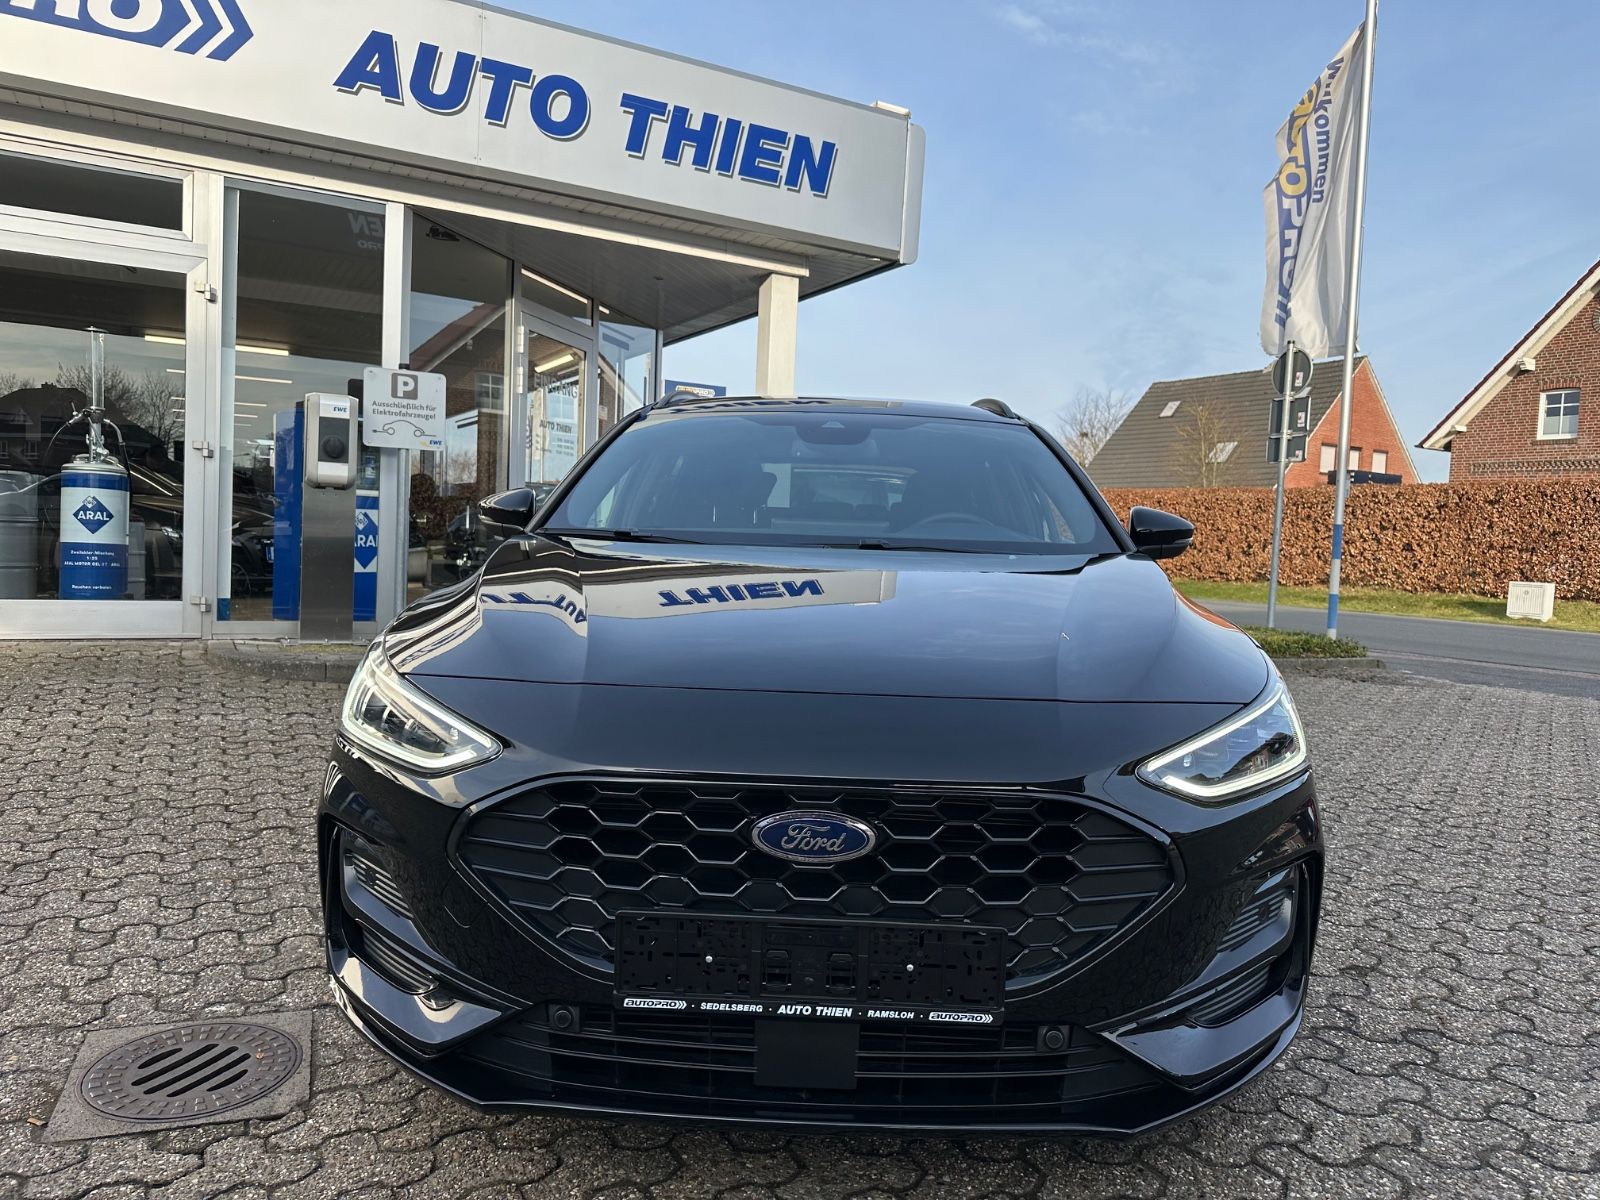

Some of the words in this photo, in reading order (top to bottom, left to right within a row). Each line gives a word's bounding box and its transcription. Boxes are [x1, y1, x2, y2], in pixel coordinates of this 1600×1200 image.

[333, 30, 590, 140] AUTO
[620, 92, 839, 198] THIEN
[1311, 56, 1345, 203] Wkommen
[397, 375, 415, 397] P
[372, 400, 425, 411] Ausschließlich
[425, 404, 436, 412] für
[539, 420, 555, 431] AUTO
[556, 422, 572, 434] THIEN
[77, 510, 110, 520] ARAL
[354, 534, 379, 547] RA
[781, 823, 847, 852] Ford
[700, 1002, 763, 1012] SEDELSBERG
[777, 1005, 812, 1015] AUTO
[815, 1006, 852, 1017] THIEN
[867, 1010, 914, 1019] RAMSLOH
